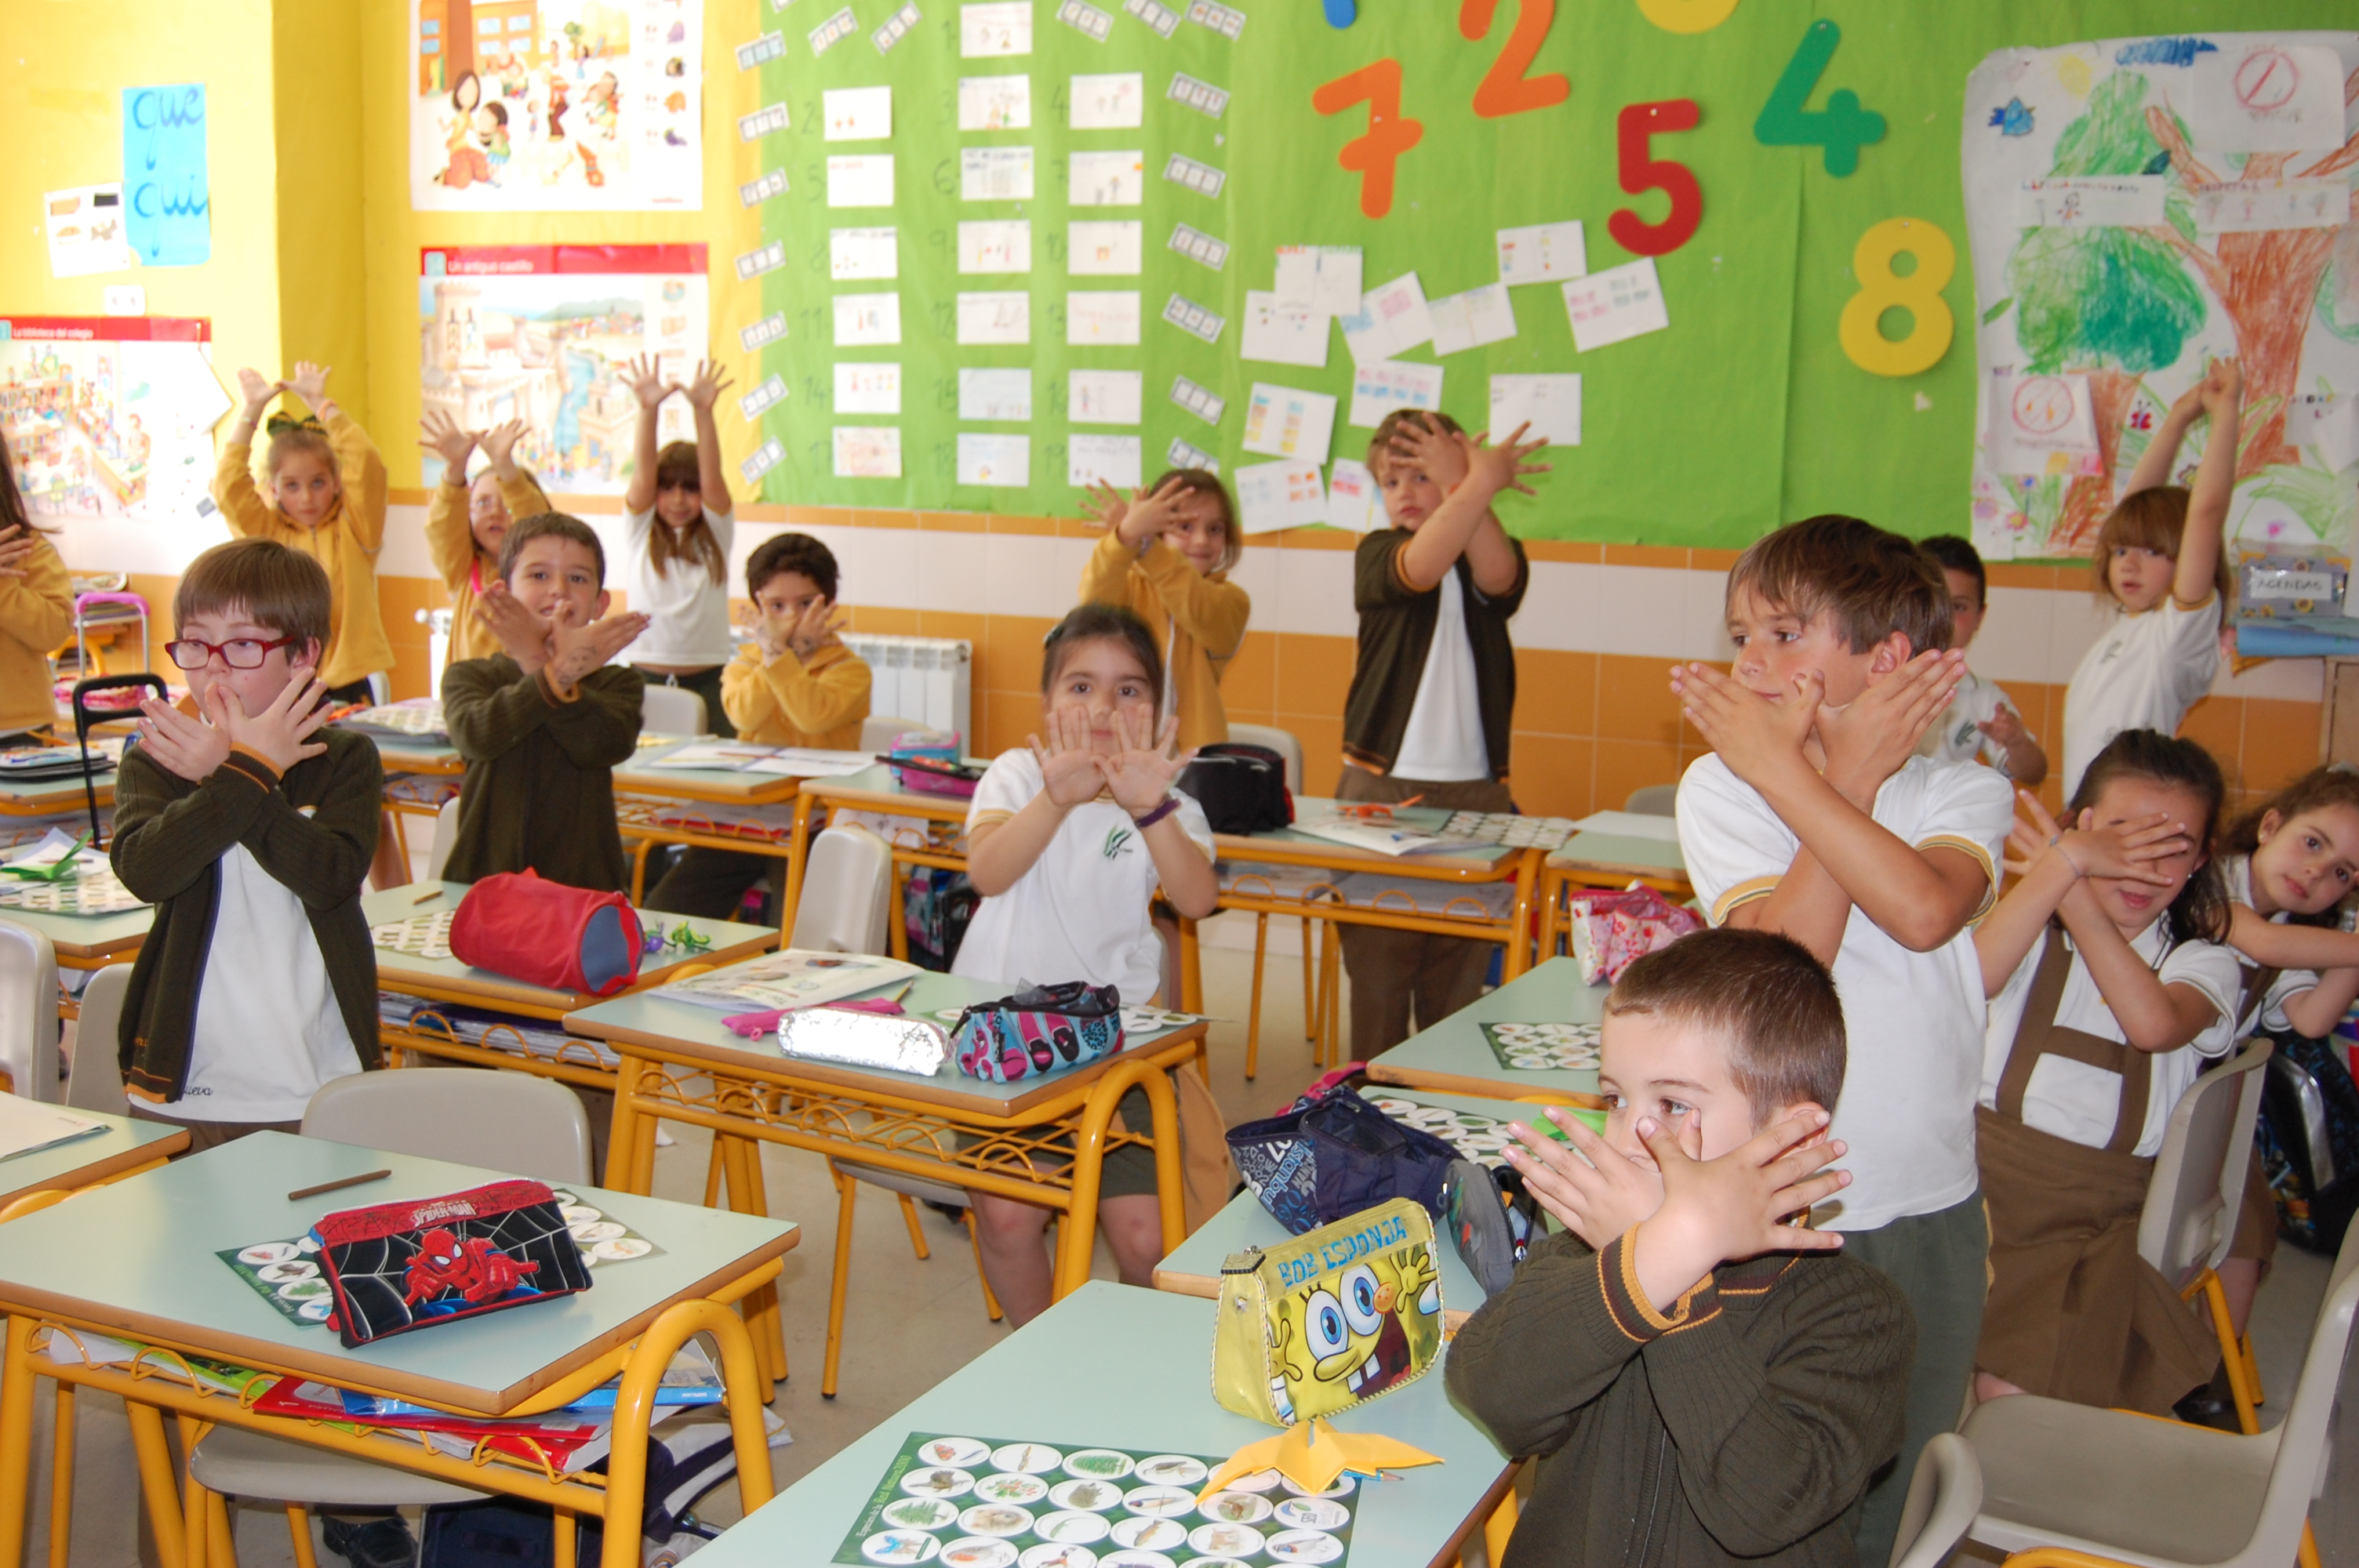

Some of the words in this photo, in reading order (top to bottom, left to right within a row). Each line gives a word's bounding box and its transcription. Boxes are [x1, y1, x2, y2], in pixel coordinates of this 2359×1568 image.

[1458, 0, 1570, 118] 2
[1754, 19, 1887, 178] 4
[1312, 58, 1423, 220] 7
[1608, 98, 1702, 256] 5
[1839, 217, 1956, 376] 8
[1260, 1141, 1314, 1212] Istanbul
[1278, 1252, 1319, 1287] BOB
[1319, 1215, 1408, 1270] ESPONJA
